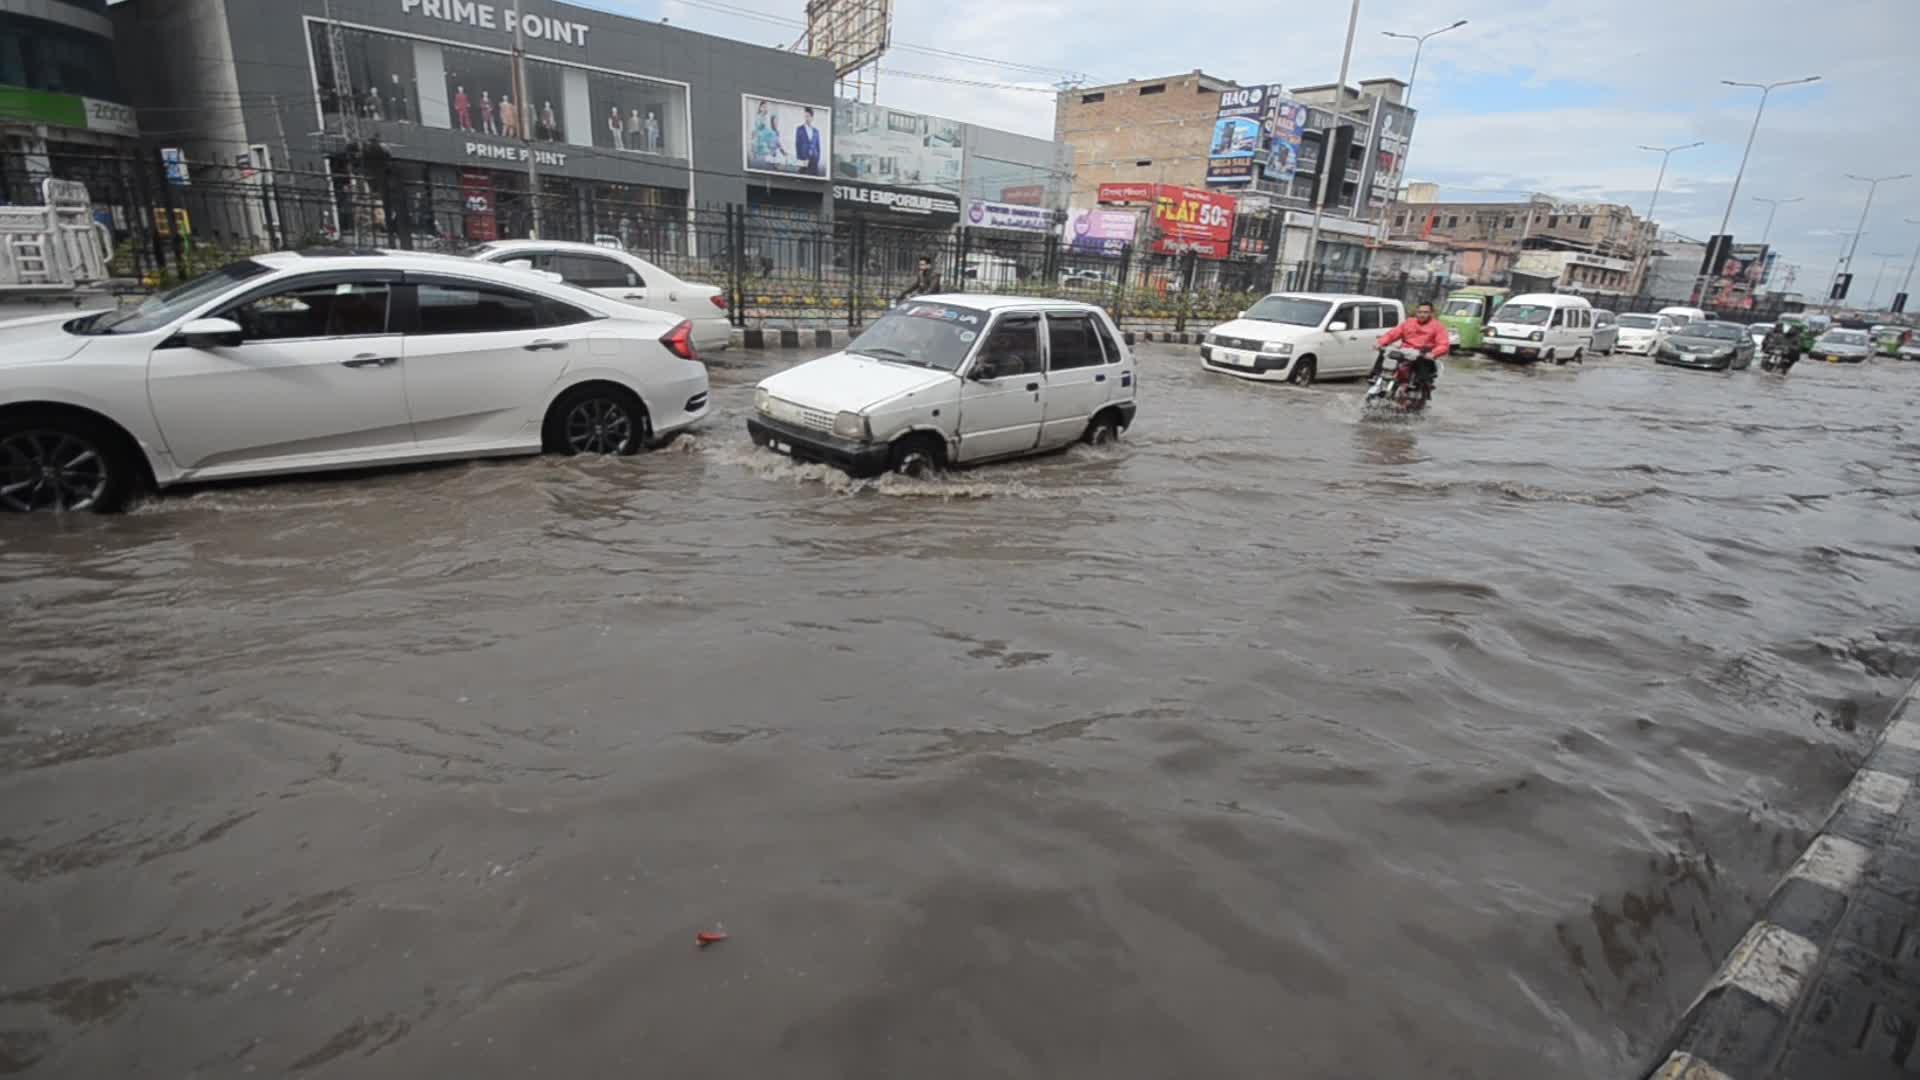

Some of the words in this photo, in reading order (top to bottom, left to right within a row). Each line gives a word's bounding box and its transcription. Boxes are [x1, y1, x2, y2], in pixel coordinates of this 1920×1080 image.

[401, 0, 496, 29] PRIME
[504, 9, 588, 46] POINT
[1221, 89, 1249, 107] HAQ
[465, 142, 517, 161] PRIME
[832, 185, 869, 202] STILE
[869, 189, 932, 209] EMPORIUM
[1156, 196, 1201, 223] FLAT
